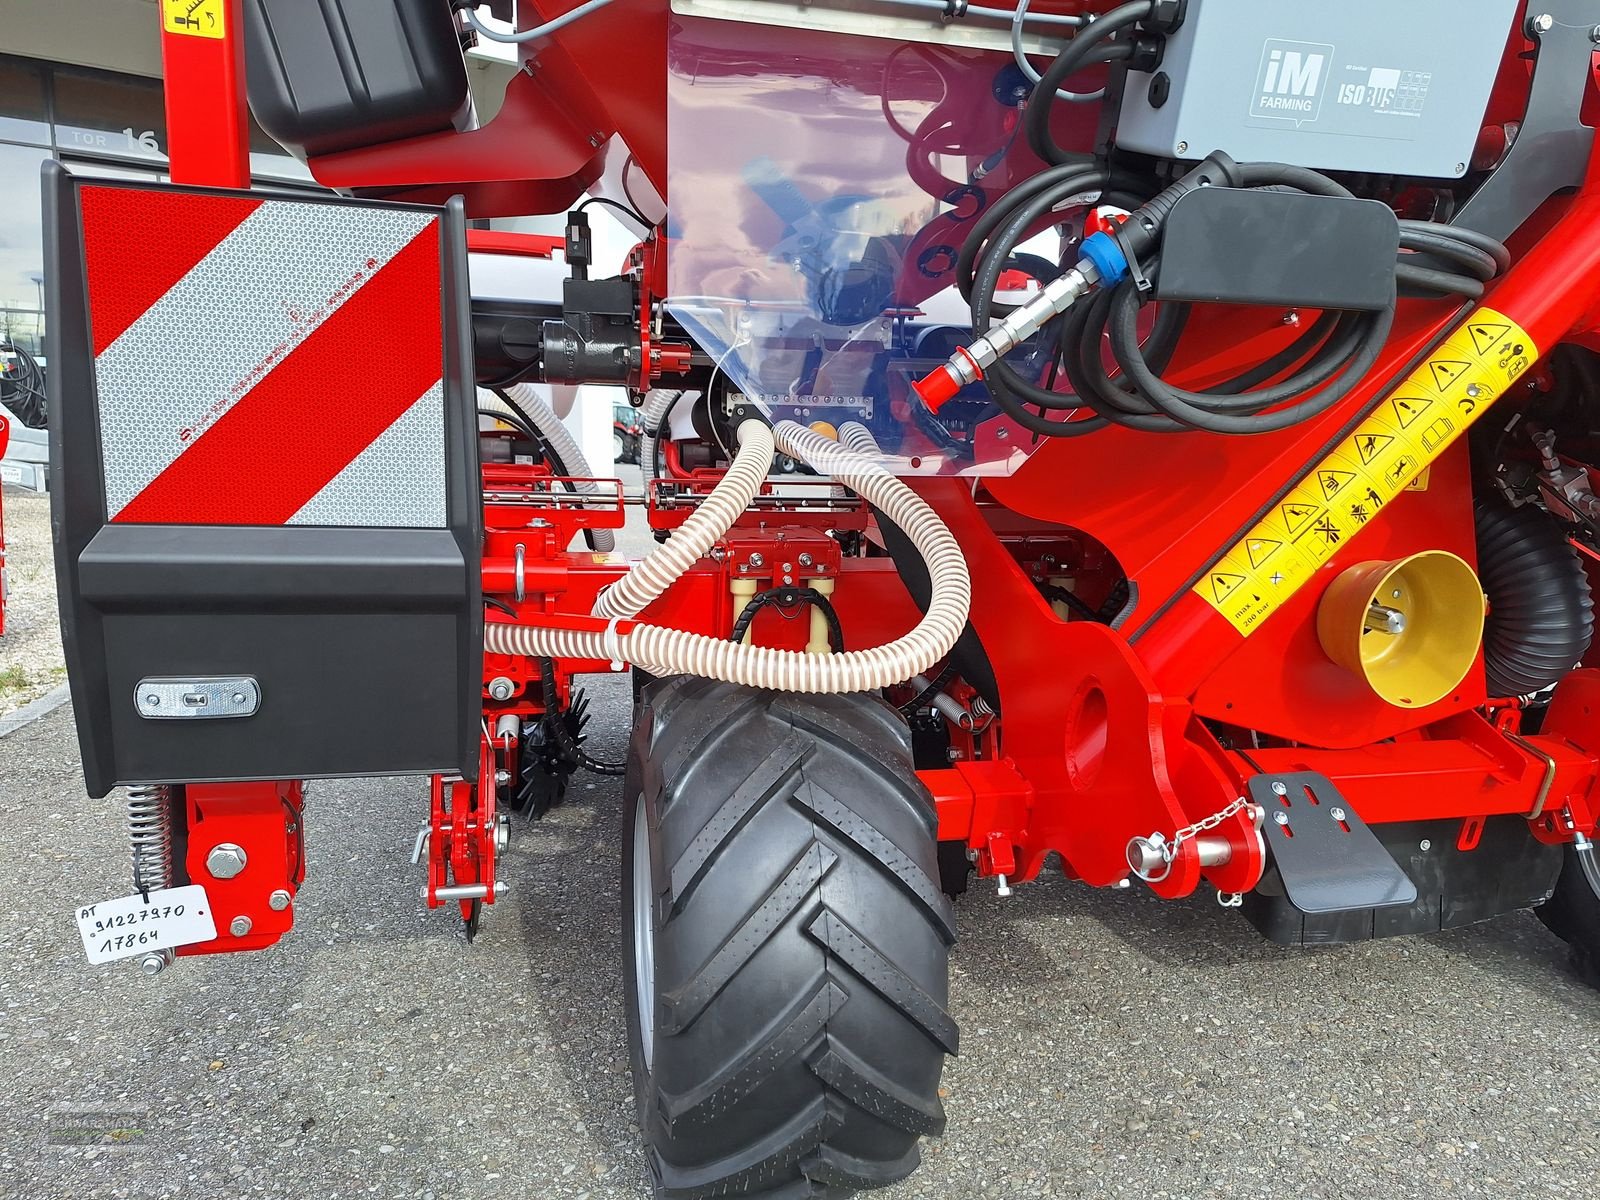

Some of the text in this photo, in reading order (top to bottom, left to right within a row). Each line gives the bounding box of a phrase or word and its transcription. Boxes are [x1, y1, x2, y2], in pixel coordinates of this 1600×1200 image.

[1263, 50, 1324, 97] iM
[1259, 96, 1312, 112] FARMING
[72, 127, 159, 154] TOR 16
[1243, 602, 1270, 628] 200 bar
[81, 905, 97, 920] AT
[95, 904, 185, 933] 91227970
[99, 929, 159, 953] 17864
